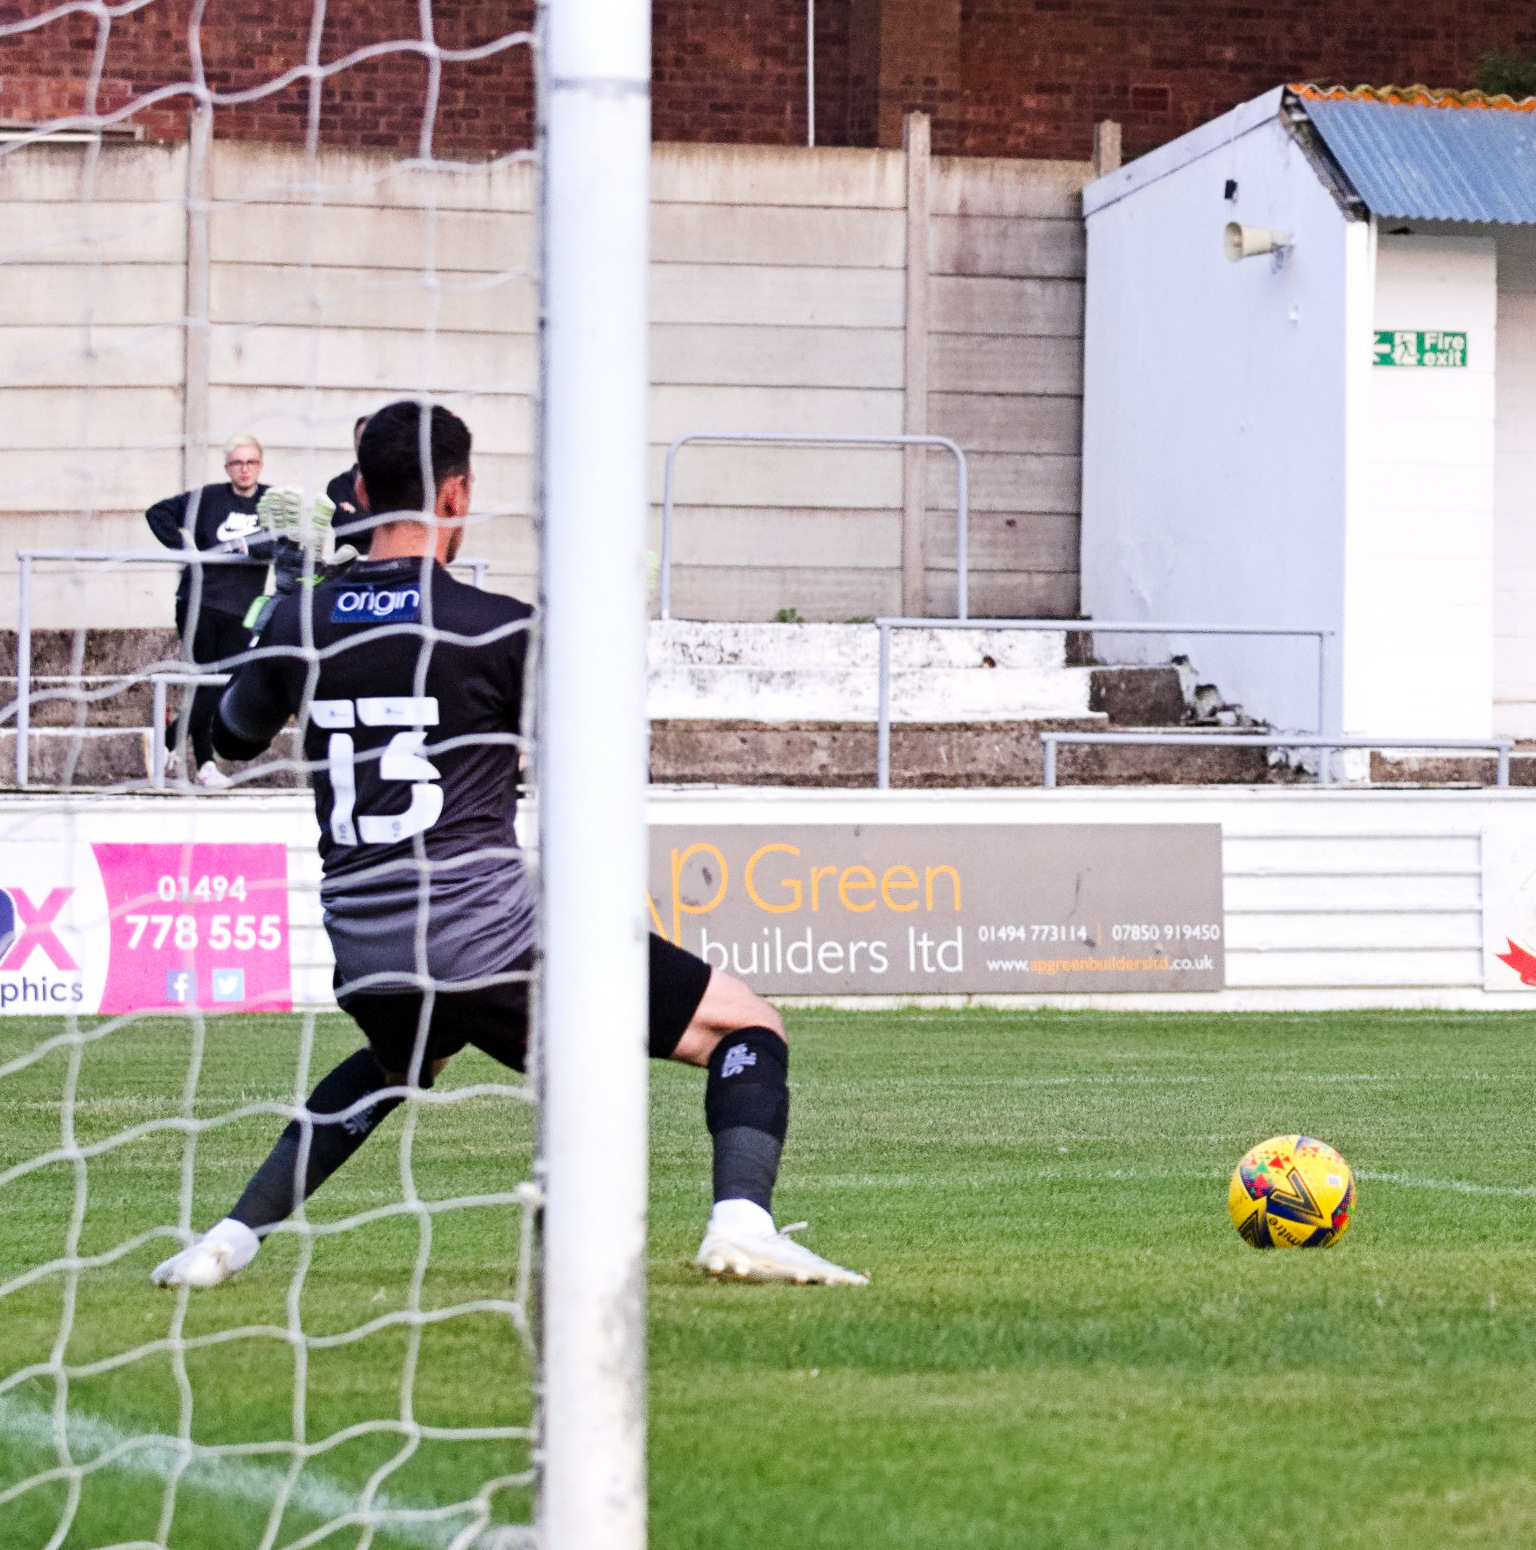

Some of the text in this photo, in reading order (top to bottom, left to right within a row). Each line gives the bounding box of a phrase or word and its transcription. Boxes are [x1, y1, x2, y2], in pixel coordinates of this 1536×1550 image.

[1424, 331, 1465, 350] Fire
[1424, 349, 1462, 366] exit
[336, 585, 420, 617] origin
[307, 696, 445, 846] 13
[157, 874, 248, 903] 01494
[744, 842, 962, 914] Green
[124, 913, 282, 951] 778 555
[977, 924, 1088, 942] 01494 773114
[1111, 923, 1221, 941] 07850 919450
[700, 925, 964, 975] builders ltd
